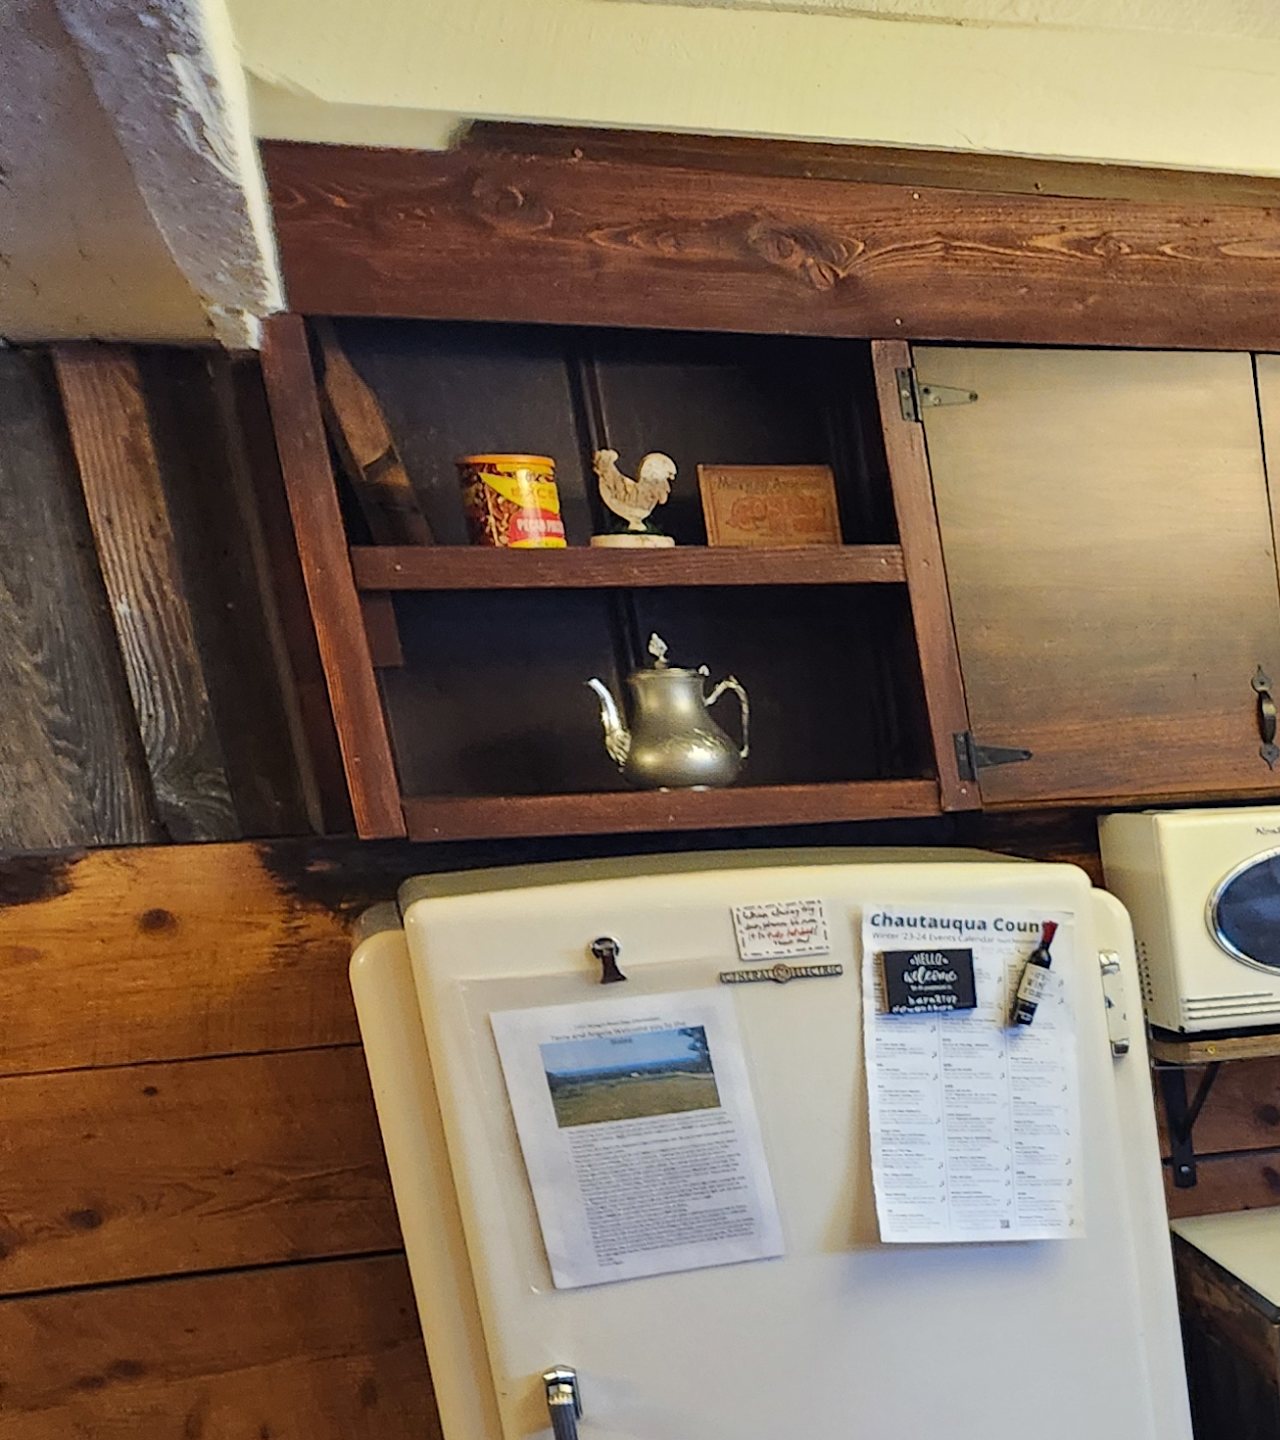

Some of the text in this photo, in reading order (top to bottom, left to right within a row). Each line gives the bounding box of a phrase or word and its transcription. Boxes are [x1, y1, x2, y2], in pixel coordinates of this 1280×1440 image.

[870, 912, 1041, 934] Chautauqua Coun
[957, 933, 994, 943] Calendar
[913, 952, 943, 966] HELLO
